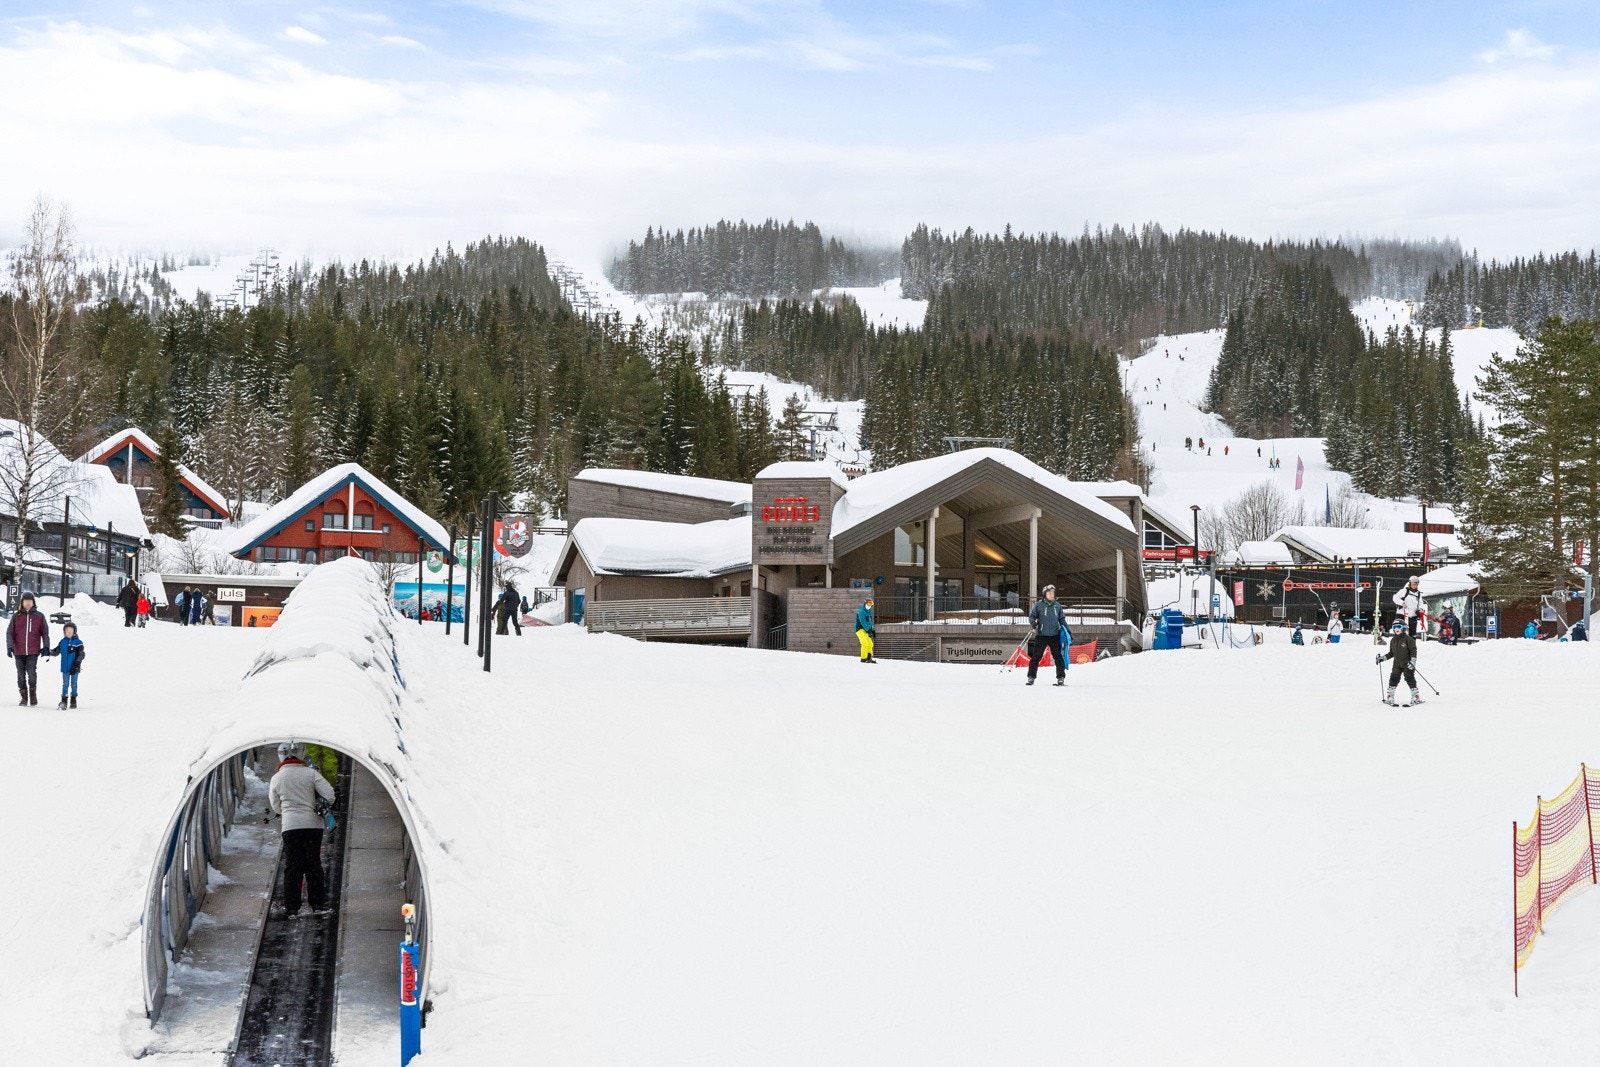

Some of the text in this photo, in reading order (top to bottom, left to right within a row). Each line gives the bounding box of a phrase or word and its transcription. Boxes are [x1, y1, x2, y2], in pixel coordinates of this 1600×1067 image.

[762, 505, 820, 523] GUIDES
[220, 589, 244, 599] juls
[946, 647, 1003, 657] Trysilguidene
